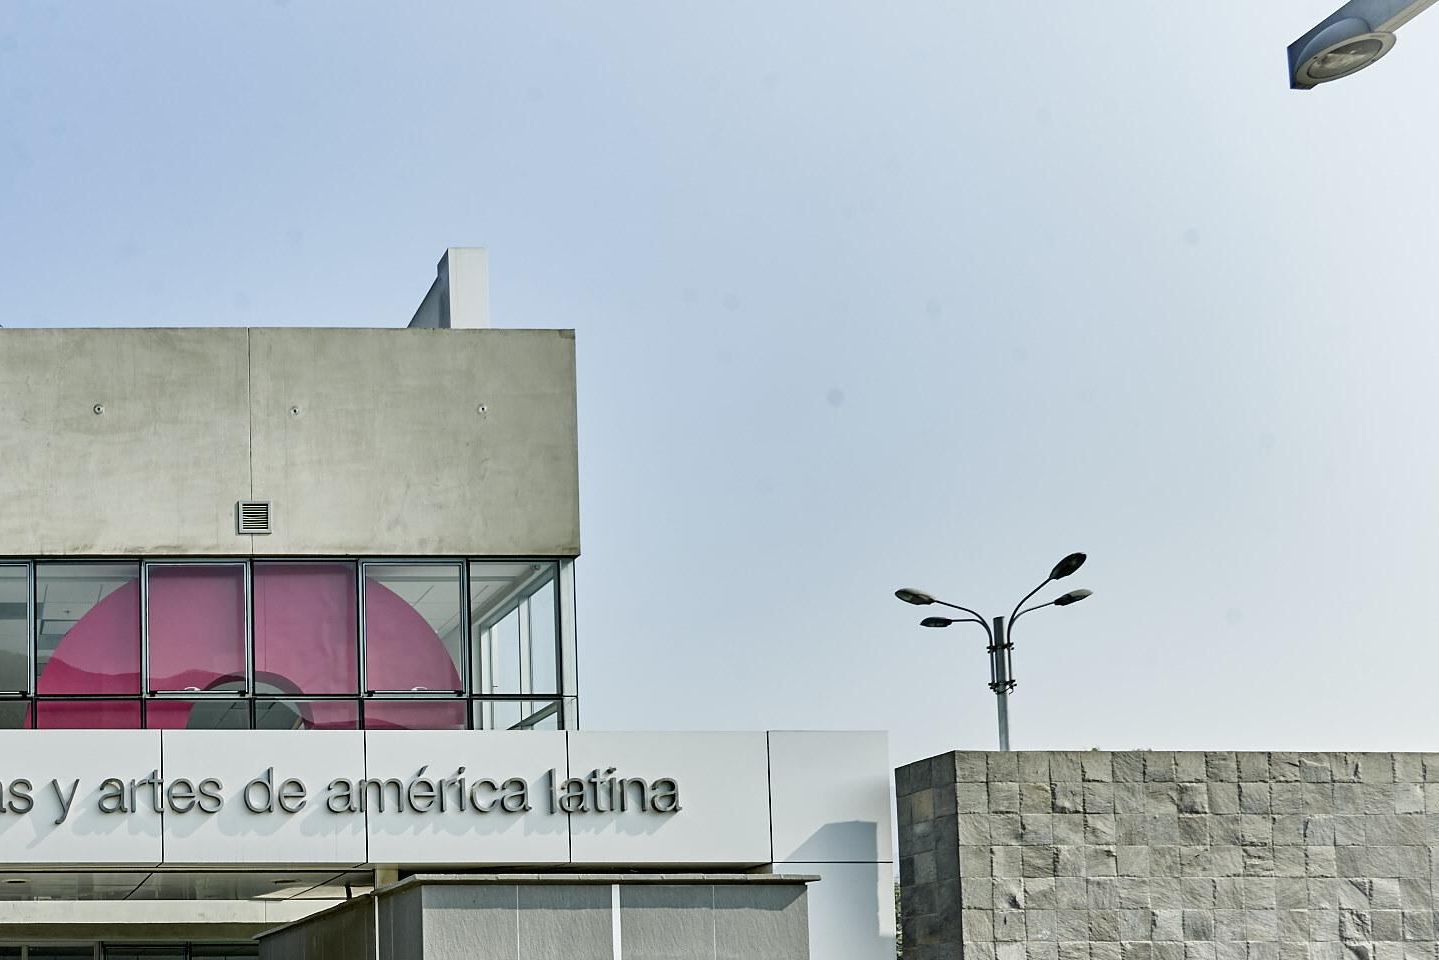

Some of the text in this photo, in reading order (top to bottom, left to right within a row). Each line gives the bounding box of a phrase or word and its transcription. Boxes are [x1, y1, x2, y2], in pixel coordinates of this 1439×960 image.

[52, 778, 80, 825] y
[98, 769, 223, 815] artes
[244, 767, 307, 814] de
[326, 765, 532, 815] américa
[548, 767, 682, 815] latina
